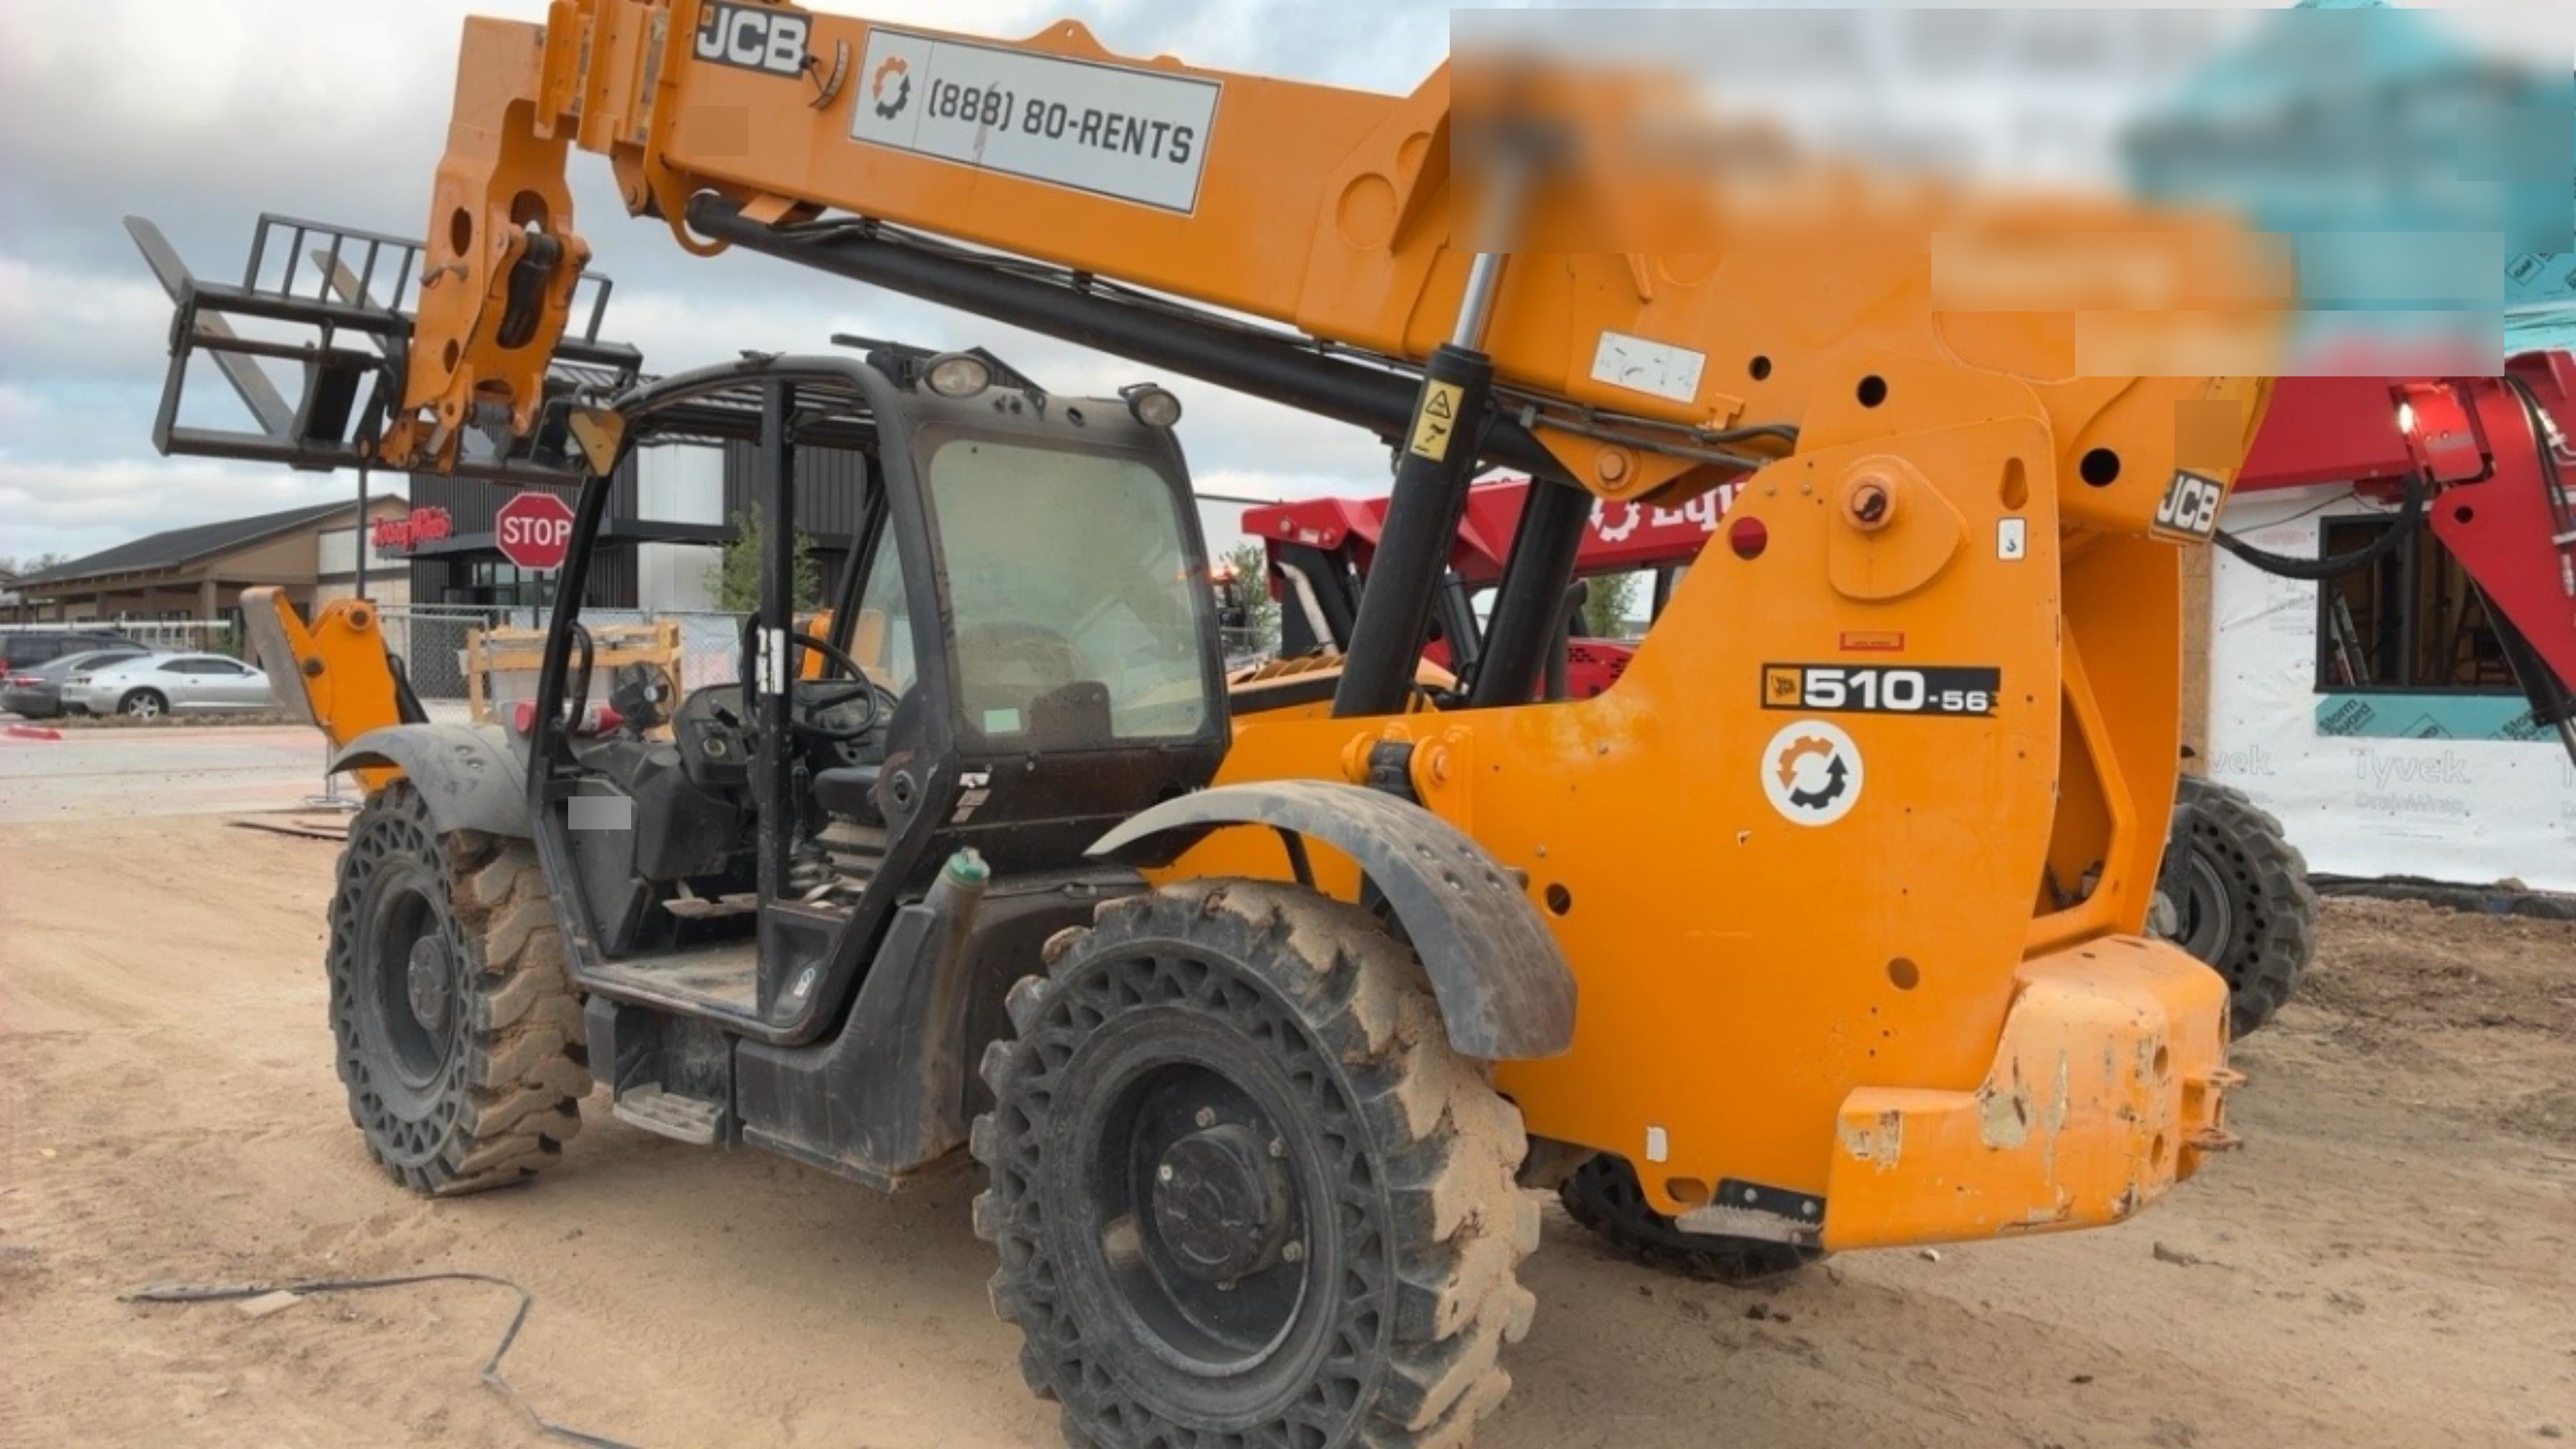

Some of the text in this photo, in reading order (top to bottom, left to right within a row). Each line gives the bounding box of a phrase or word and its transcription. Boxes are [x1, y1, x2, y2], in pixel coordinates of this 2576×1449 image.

[697, 7, 806, 74] JCB
[928, 78, 1194, 164] (888) 80-RENTS
[2157, 474, 2220, 533] JCB
[504, 516, 571, 546] STOP
[1804, 668, 1989, 712] 510-56
[2351, 748, 2469, 789] Tyvek
